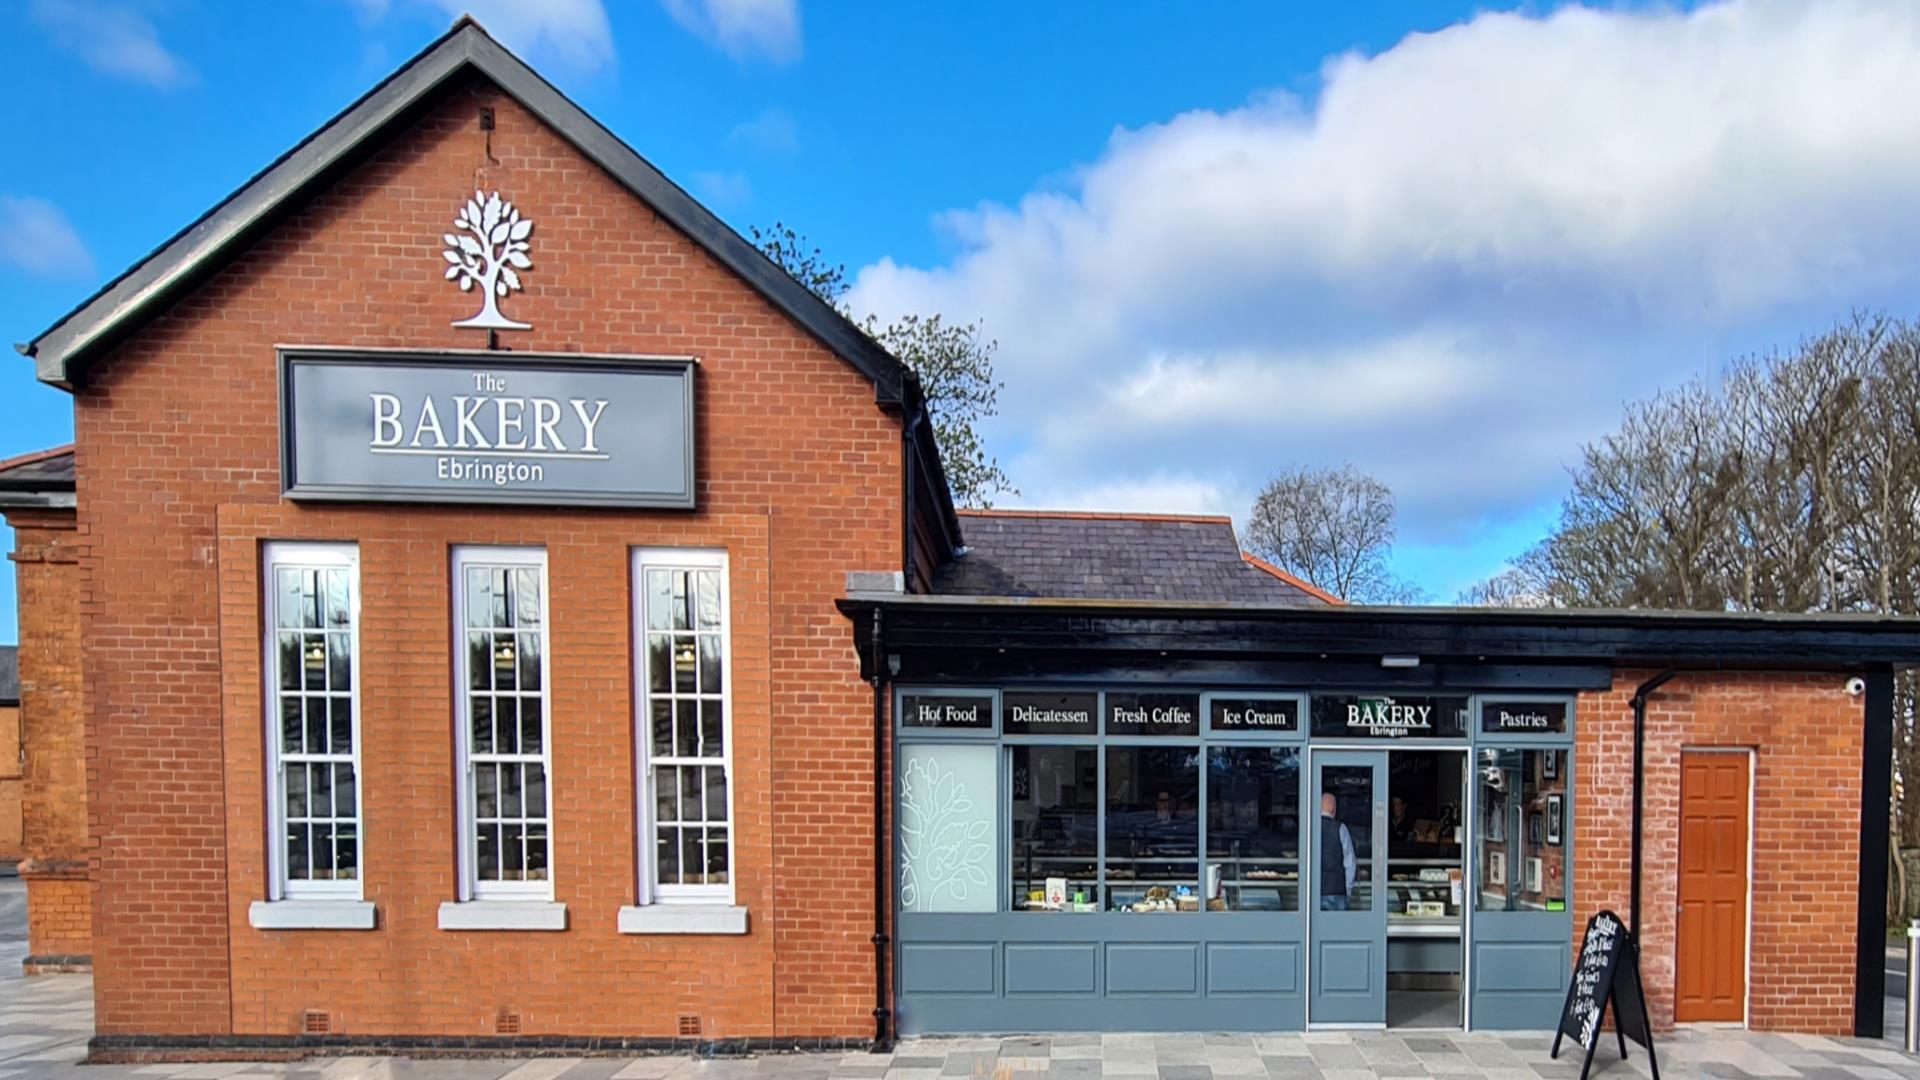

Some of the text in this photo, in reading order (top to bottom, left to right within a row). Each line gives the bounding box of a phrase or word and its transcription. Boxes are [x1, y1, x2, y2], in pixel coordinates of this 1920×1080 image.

[473, 373, 506, 392] The
[369, 394, 610, 452] BAKERY
[437, 458, 544, 485] Ebrington
[919, 705, 977, 722] Hot Food
[1012, 706, 1088, 723] Delicatessen
[1113, 707, 1191, 723] Fresh Coffee
[1223, 708, 1286, 725] Ice Cream
[1347, 705, 1431, 726] BAKERY
[1500, 711, 1548, 726] Pastries
[1370, 726, 1408, 737] Ebrington
